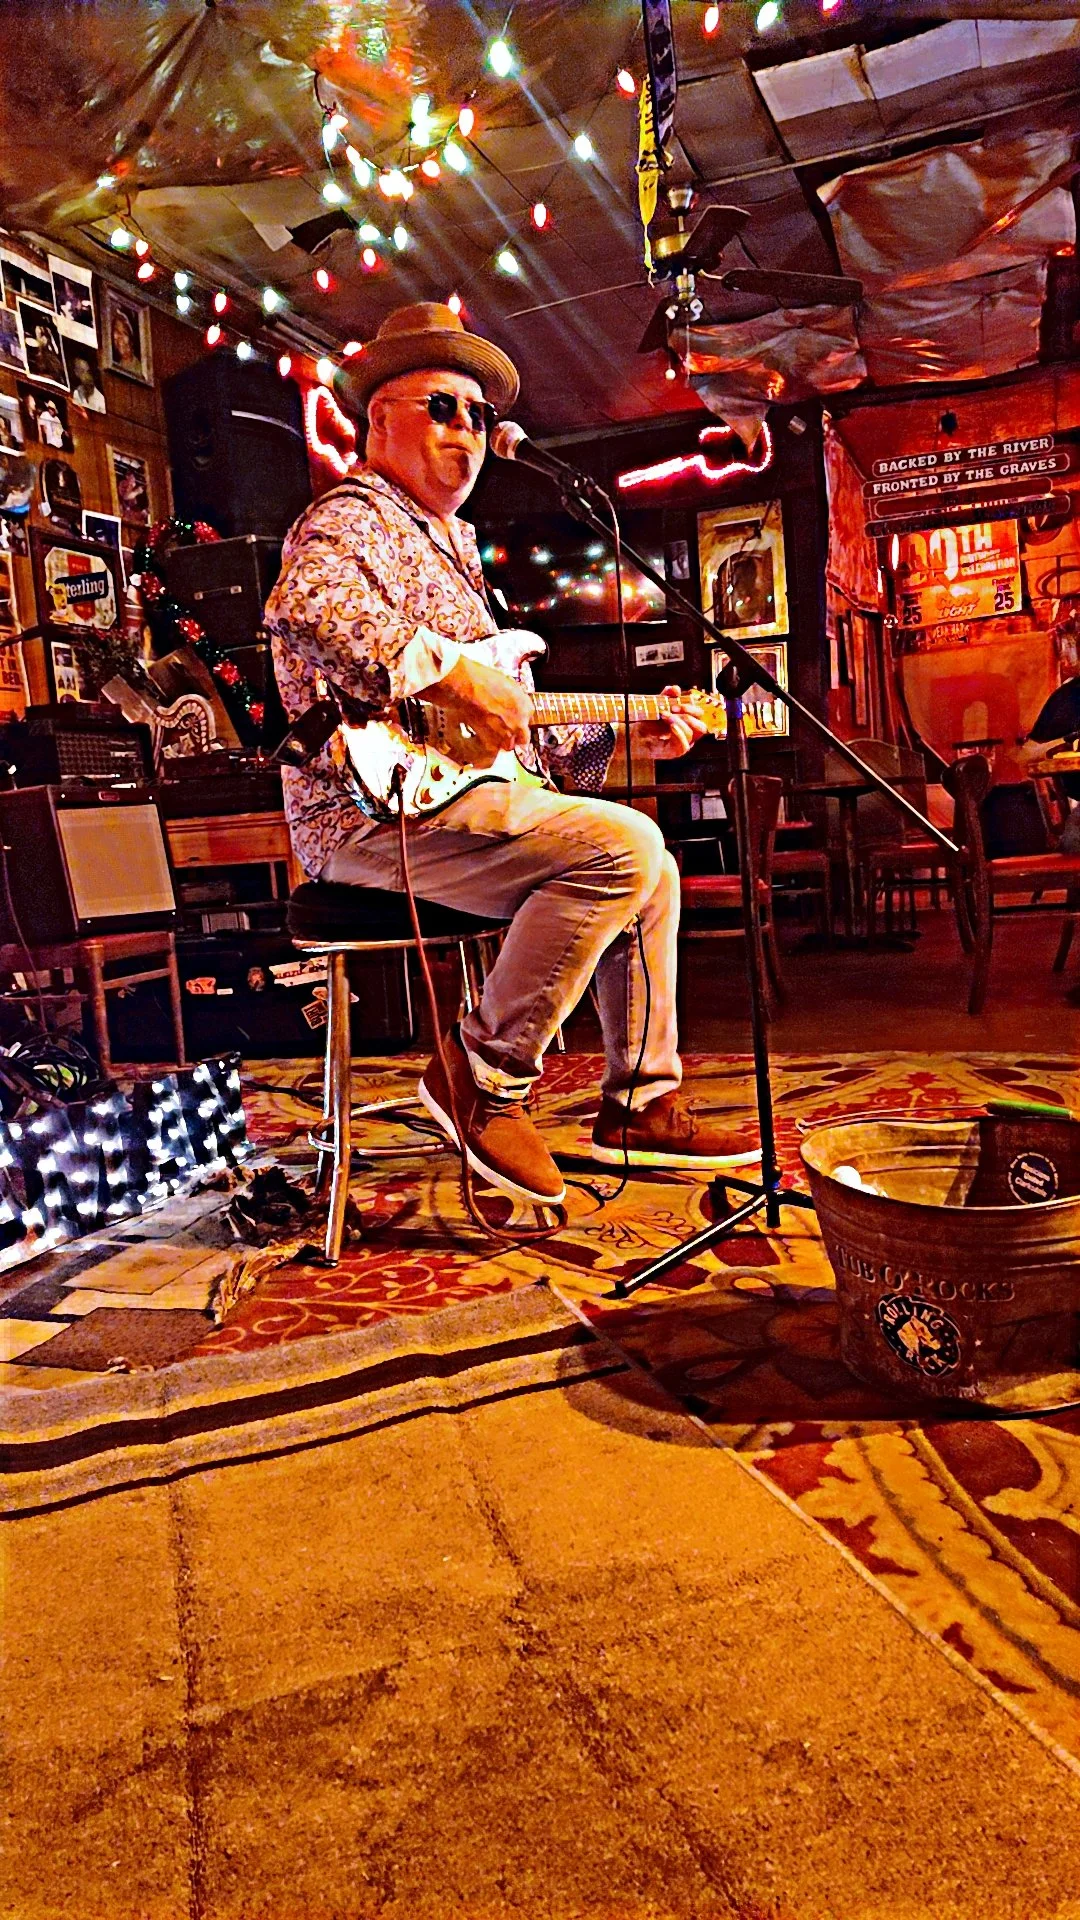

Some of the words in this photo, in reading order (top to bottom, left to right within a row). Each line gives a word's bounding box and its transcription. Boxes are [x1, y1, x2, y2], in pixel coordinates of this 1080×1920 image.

[879, 454, 938, 474] BACKED
[944, 450, 962, 463] BY
[968, 445, 997, 459] THE
[1003, 438, 1049, 454] RIVER
[872, 475, 939, 495] FRONTED
[943, 472, 961, 484] BY
[966, 467, 994, 481] THE
[1000, 457, 1057, 475] GRAVES
[66, 578, 105, 598] terling
[994, 591, 1015, 612] 25
[902, 606, 922, 625] 25
[835, 1244, 876, 1283] TUB
[913, 1271, 1015, 1302] ROCKS
[883, 1302, 944, 1330] ROLLING
